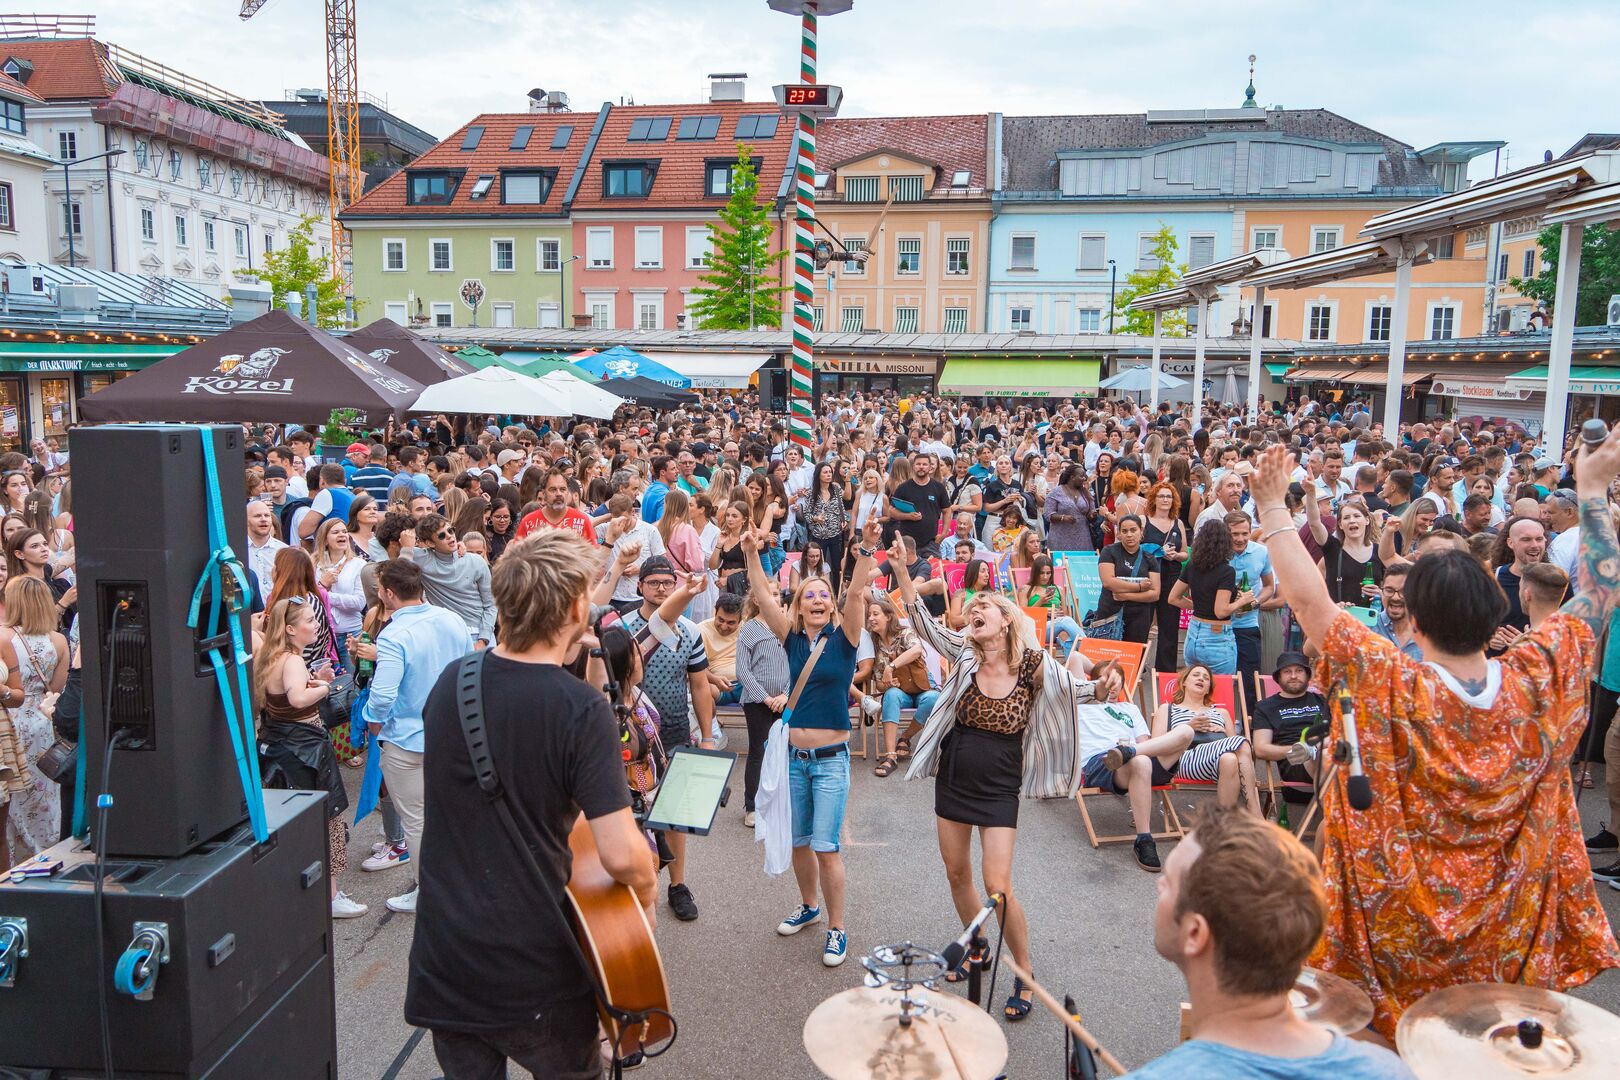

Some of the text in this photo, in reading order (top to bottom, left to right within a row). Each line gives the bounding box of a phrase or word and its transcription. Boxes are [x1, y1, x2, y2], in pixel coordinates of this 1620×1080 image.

[27, 361, 38, 369] DER
[39, 359, 83, 370] MARKTWIRT
[885, 365, 925, 373] MISSONI
[180, 376, 295, 395] Kozel
[1462, 385, 1494, 397] Stocklauser
